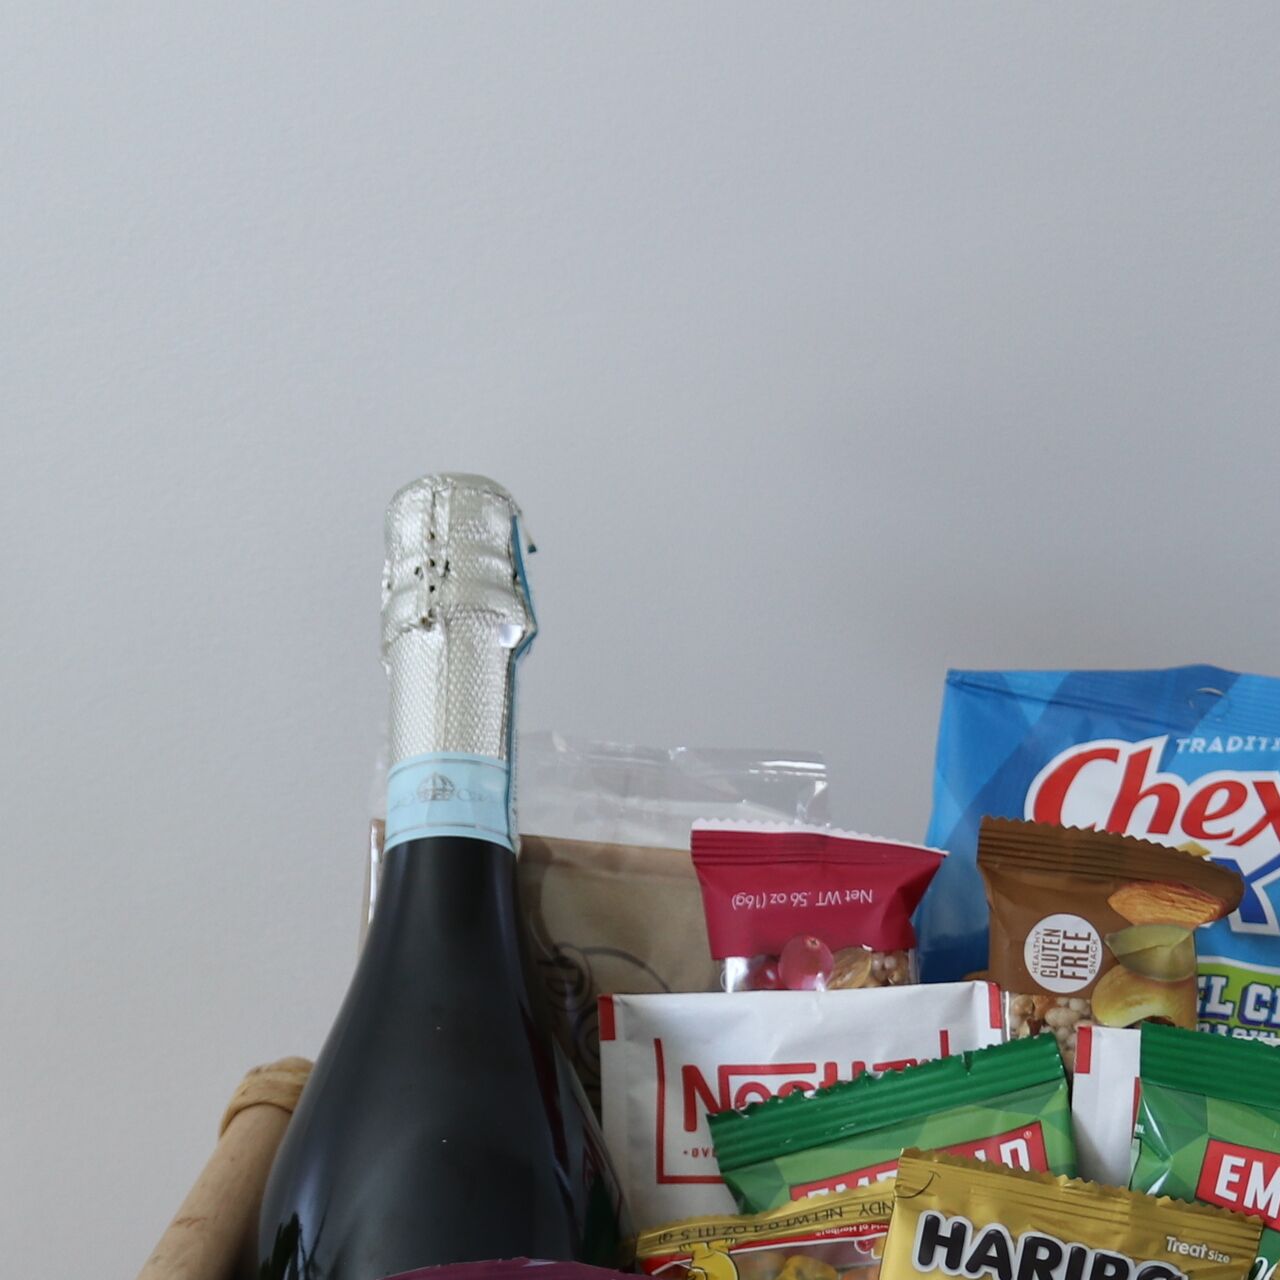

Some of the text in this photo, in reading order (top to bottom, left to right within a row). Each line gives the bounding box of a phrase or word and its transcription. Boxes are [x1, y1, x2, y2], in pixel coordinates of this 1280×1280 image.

[731, 892, 767, 911] (16g)
[769, 892, 788, 905] oz
[815, 890, 842, 907] WT
[844, 889, 873, 904] Net
[1032, 930, 1041, 974] HEALTHY
[1040, 928, 1061, 979] GLUTEN
[1060, 930, 1092, 981] FREE
[1089, 938, 1099, 975] SNACK
[858, 1199, 895, 1218] NDY
[1166, 1235, 1208, 1259] Treat
